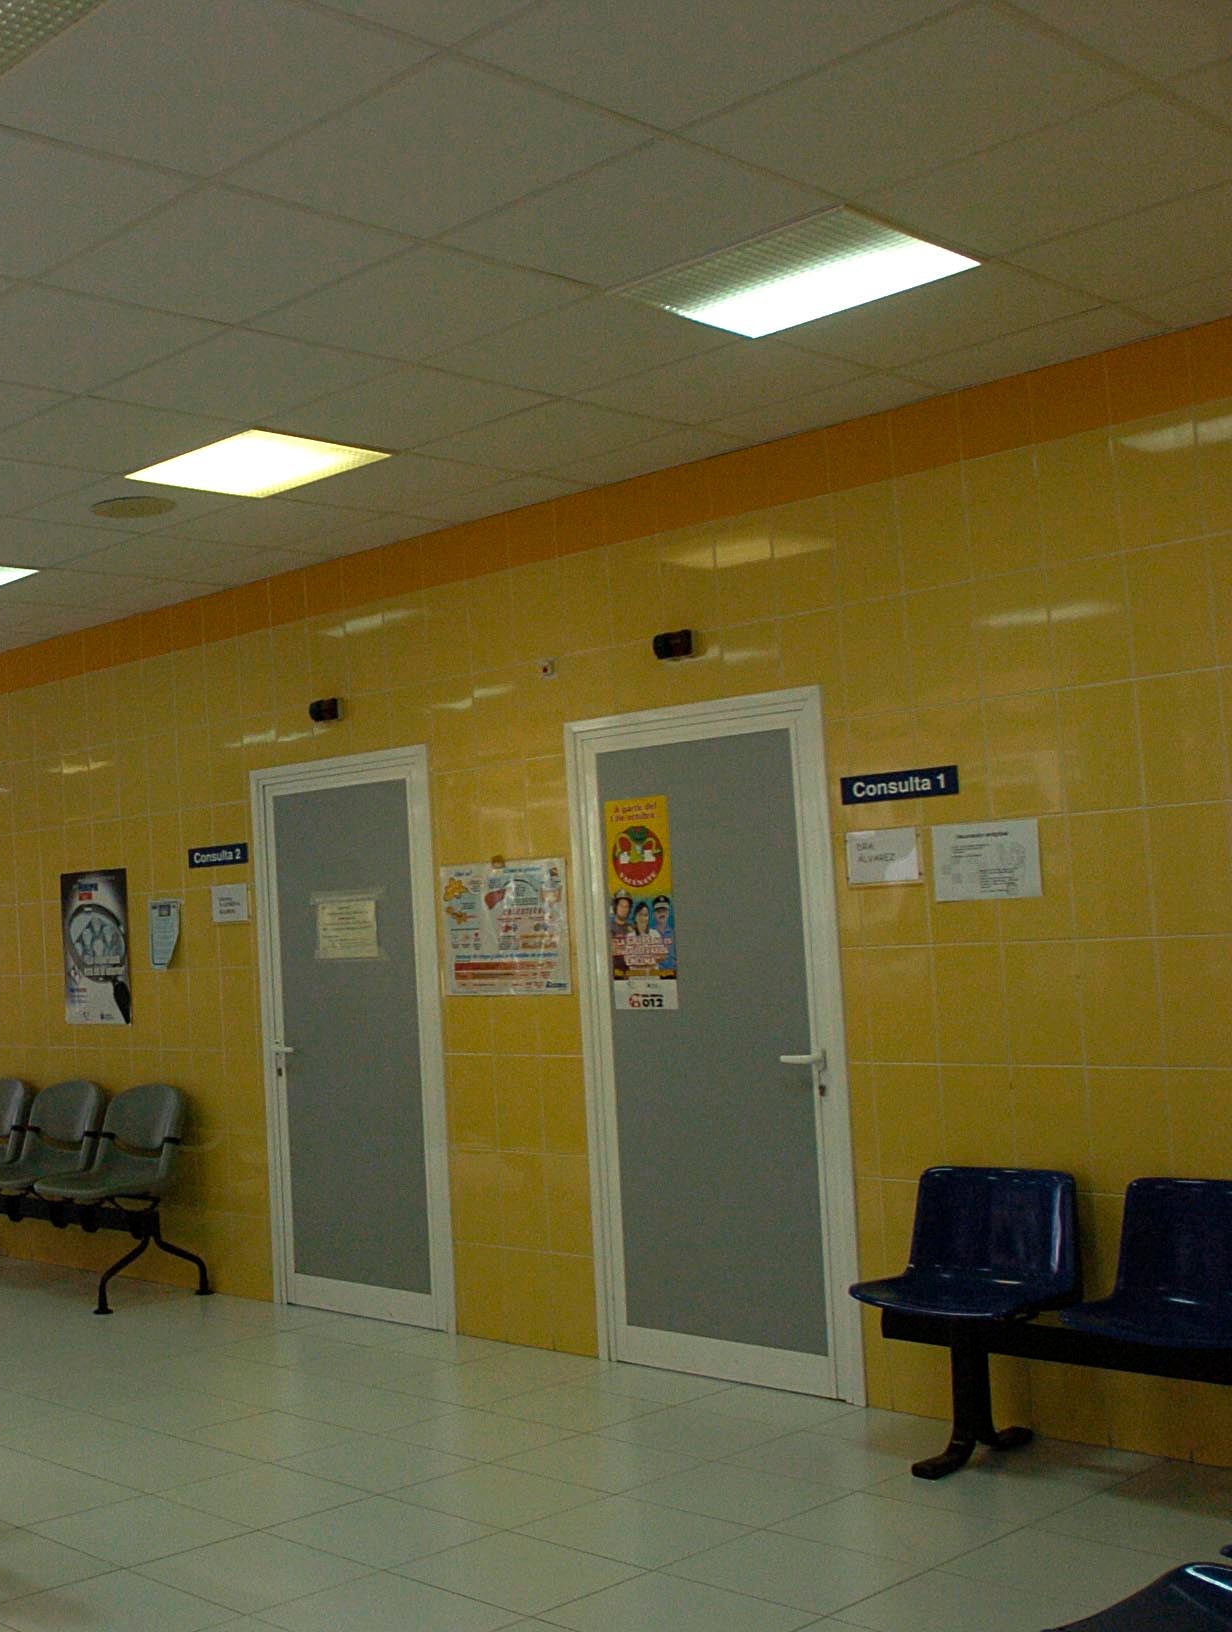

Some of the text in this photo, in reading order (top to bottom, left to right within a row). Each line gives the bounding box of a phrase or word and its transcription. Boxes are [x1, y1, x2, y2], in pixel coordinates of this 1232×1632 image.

[852, 772, 947, 799] Consulta 1
[193, 848, 242, 864] Consulta 2
[642, 998, 664, 1008] 012
